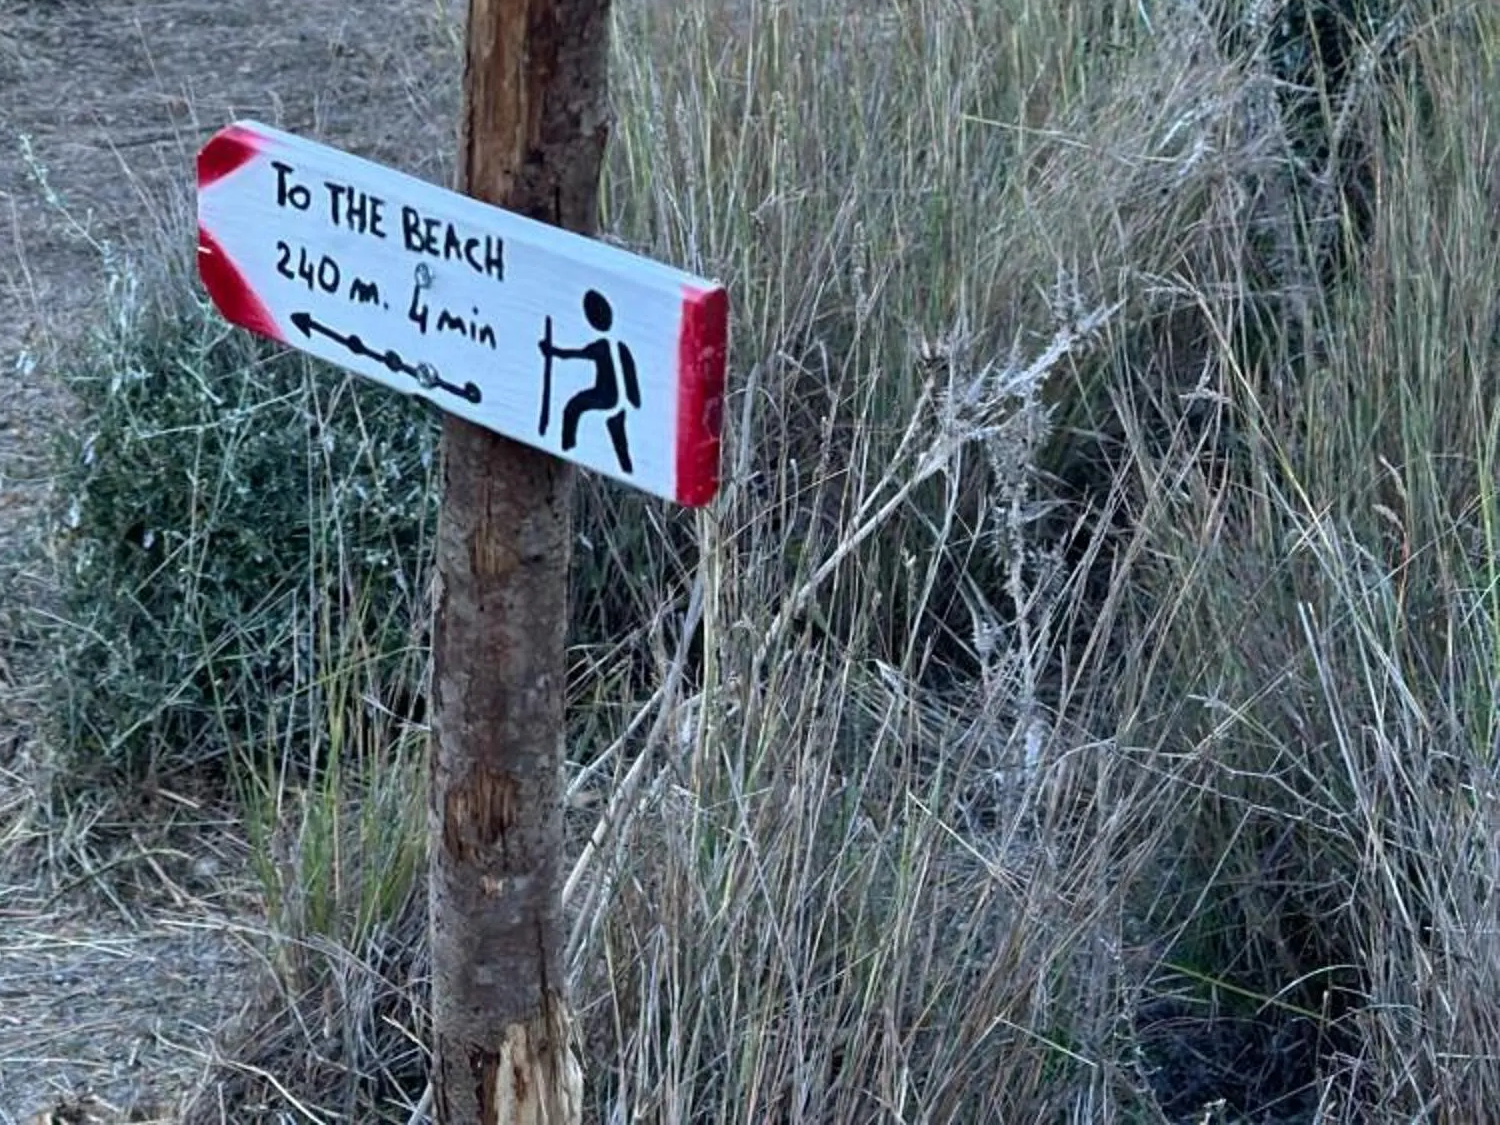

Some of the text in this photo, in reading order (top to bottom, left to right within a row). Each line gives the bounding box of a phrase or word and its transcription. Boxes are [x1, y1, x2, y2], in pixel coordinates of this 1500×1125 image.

[323, 181, 388, 239] THE
[401, 205, 504, 282] BEACH
[276, 240, 341, 294] 240
[348, 276, 390, 311] m.
